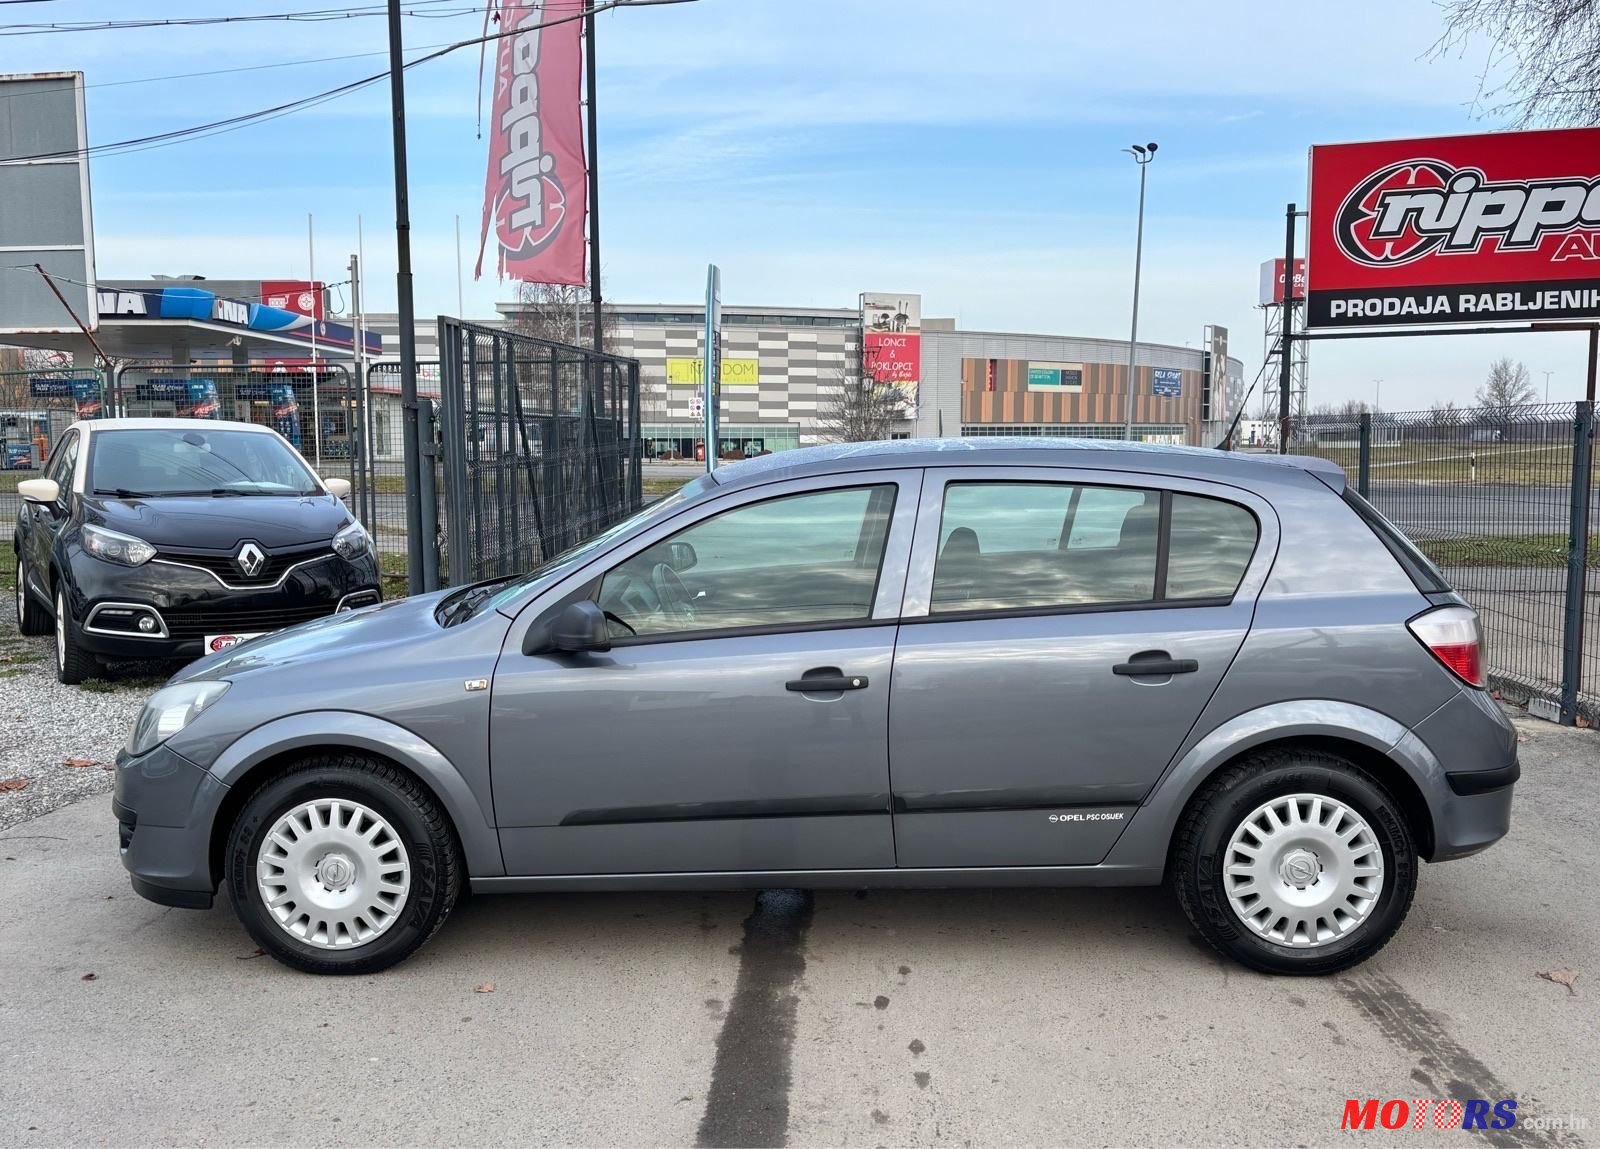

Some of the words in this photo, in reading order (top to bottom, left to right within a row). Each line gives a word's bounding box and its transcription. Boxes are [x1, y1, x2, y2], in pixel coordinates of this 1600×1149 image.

[1330, 295, 1452, 318] PRODAJA
[878, 337, 907, 347] LONCI
[889, 351, 896, 359] &
[871, 362, 913, 371] POKLOPCI
[1059, 814, 1085, 822] OPEL
[1086, 813, 1100, 821] PSC
[1101, 813, 1124, 821] OSIJEK
